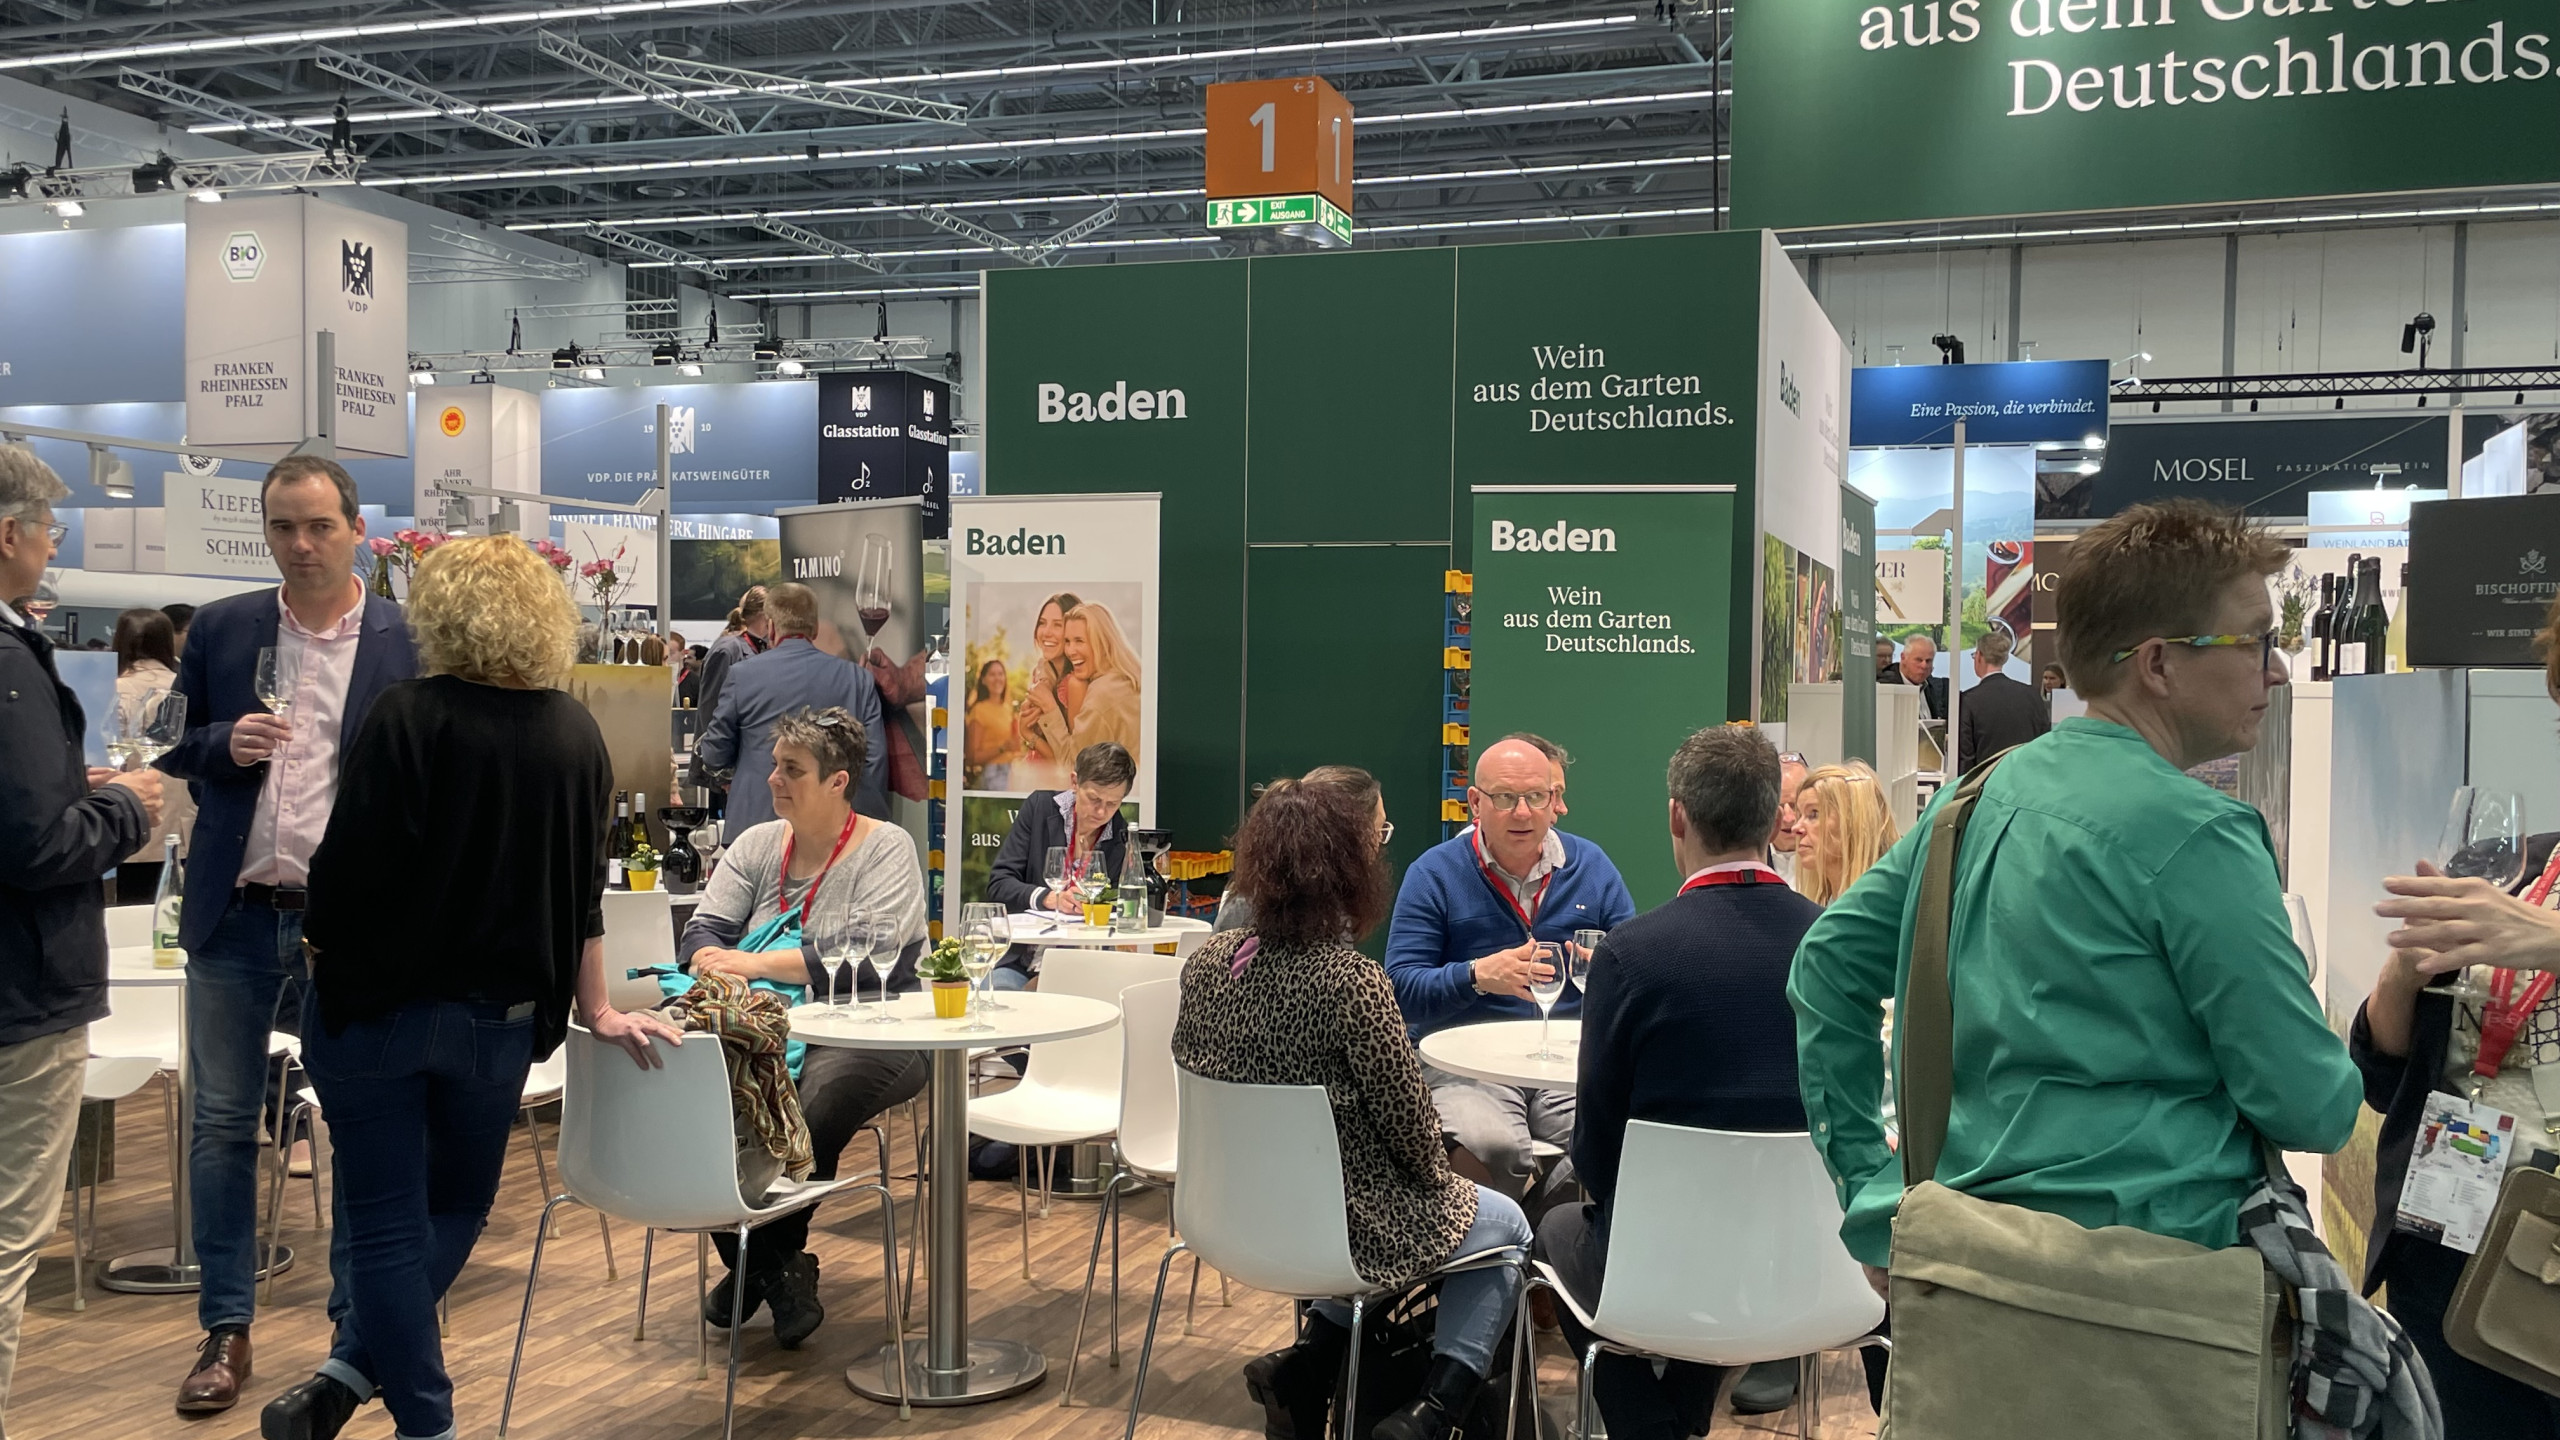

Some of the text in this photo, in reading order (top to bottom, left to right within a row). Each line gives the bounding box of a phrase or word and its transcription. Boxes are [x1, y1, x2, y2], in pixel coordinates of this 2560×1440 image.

[1859, 0, 1981, 50] aus
[1306, 80, 1314, 94] 3
[1249, 102, 1276, 172] 1
[1331, 117, 1342, 185] 1
[1270, 200, 1287, 209] EXIT
[1269, 210, 1306, 220] AUSGANG
[347, 299, 369, 314] VDP
[1532, 343, 1605, 370] Wein
[213, 361, 274, 376] FRANKEN
[200, 377, 288, 393] RHEINHESSEN
[335, 382, 397, 406] EINHESSEN
[1473, 373, 1702, 403] aus dem Garten
[1780, 360, 1801, 420] Baden
[225, 394, 264, 408] PFALZ
[341, 400, 376, 417] PFALZ
[1038, 380, 1188, 423] Baden
[1910, 398, 2096, 418] Eine Passion, die verbindet.
[1529, 401, 1735, 433] Deutschlands.
[643, 423, 712, 434] 19 10
[823, 424, 900, 438] Glasstation
[908, 424, 948, 447] Glasstation
[443, 468, 462, 478] AHR
[587, 468, 771, 484] VDP. DIE PRÄKATSWEINGÜTER
[2153, 457, 2255, 483] MOSEL
[2276, 462, 2430, 473] FASZINATIO EIN
[201, 488, 262, 514] KIEFE
[966, 527, 1067, 556] Baden
[1491, 519, 1617, 553] Baden
[2322, 539, 2386, 549] WEINLAND
[206, 538, 274, 558] SCHMID
[1547, 585, 1603, 606] Wein
[2475, 581, 2559, 596] BISCHOFFIN
[1503, 609, 1672, 630] aus dem Garten
[1545, 633, 1696, 655] Deutschlands.
[971, 832, 1001, 848] aus
